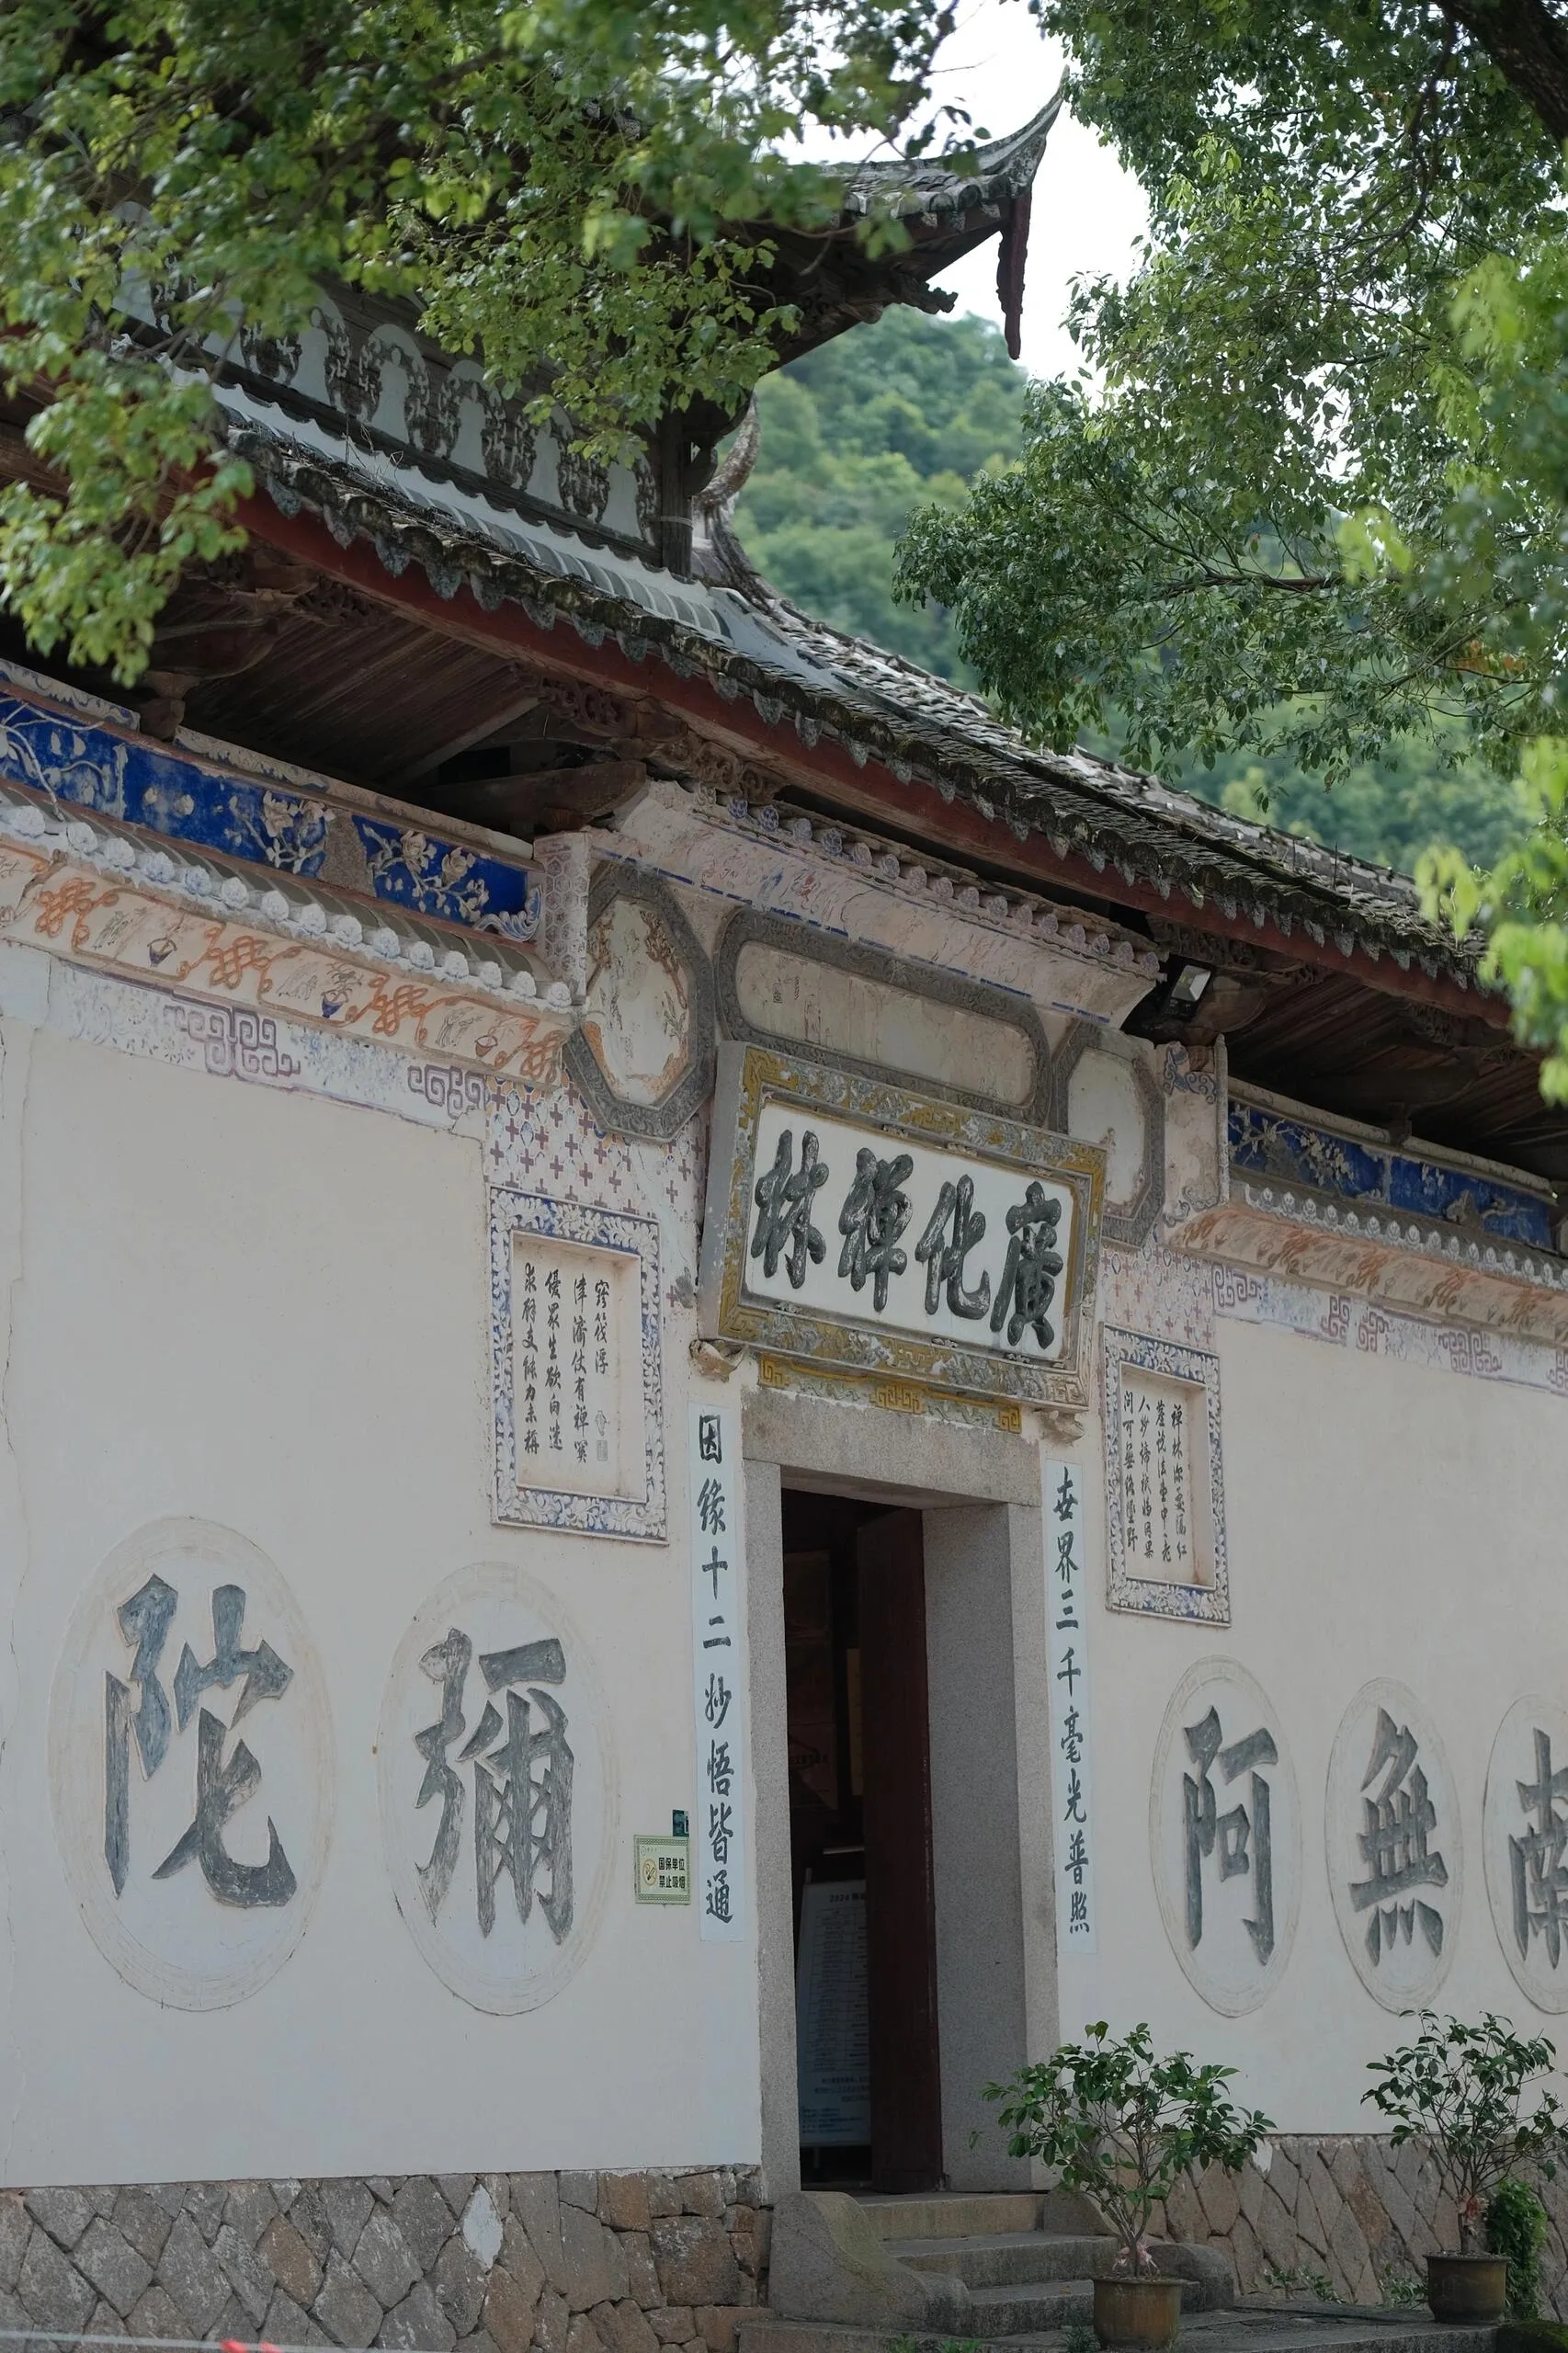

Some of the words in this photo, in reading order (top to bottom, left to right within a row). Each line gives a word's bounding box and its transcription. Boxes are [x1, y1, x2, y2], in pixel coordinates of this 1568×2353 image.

[658, 1857, 686, 1871] 国保单位
[658, 1875, 686, 1890] 禁止吸烟
